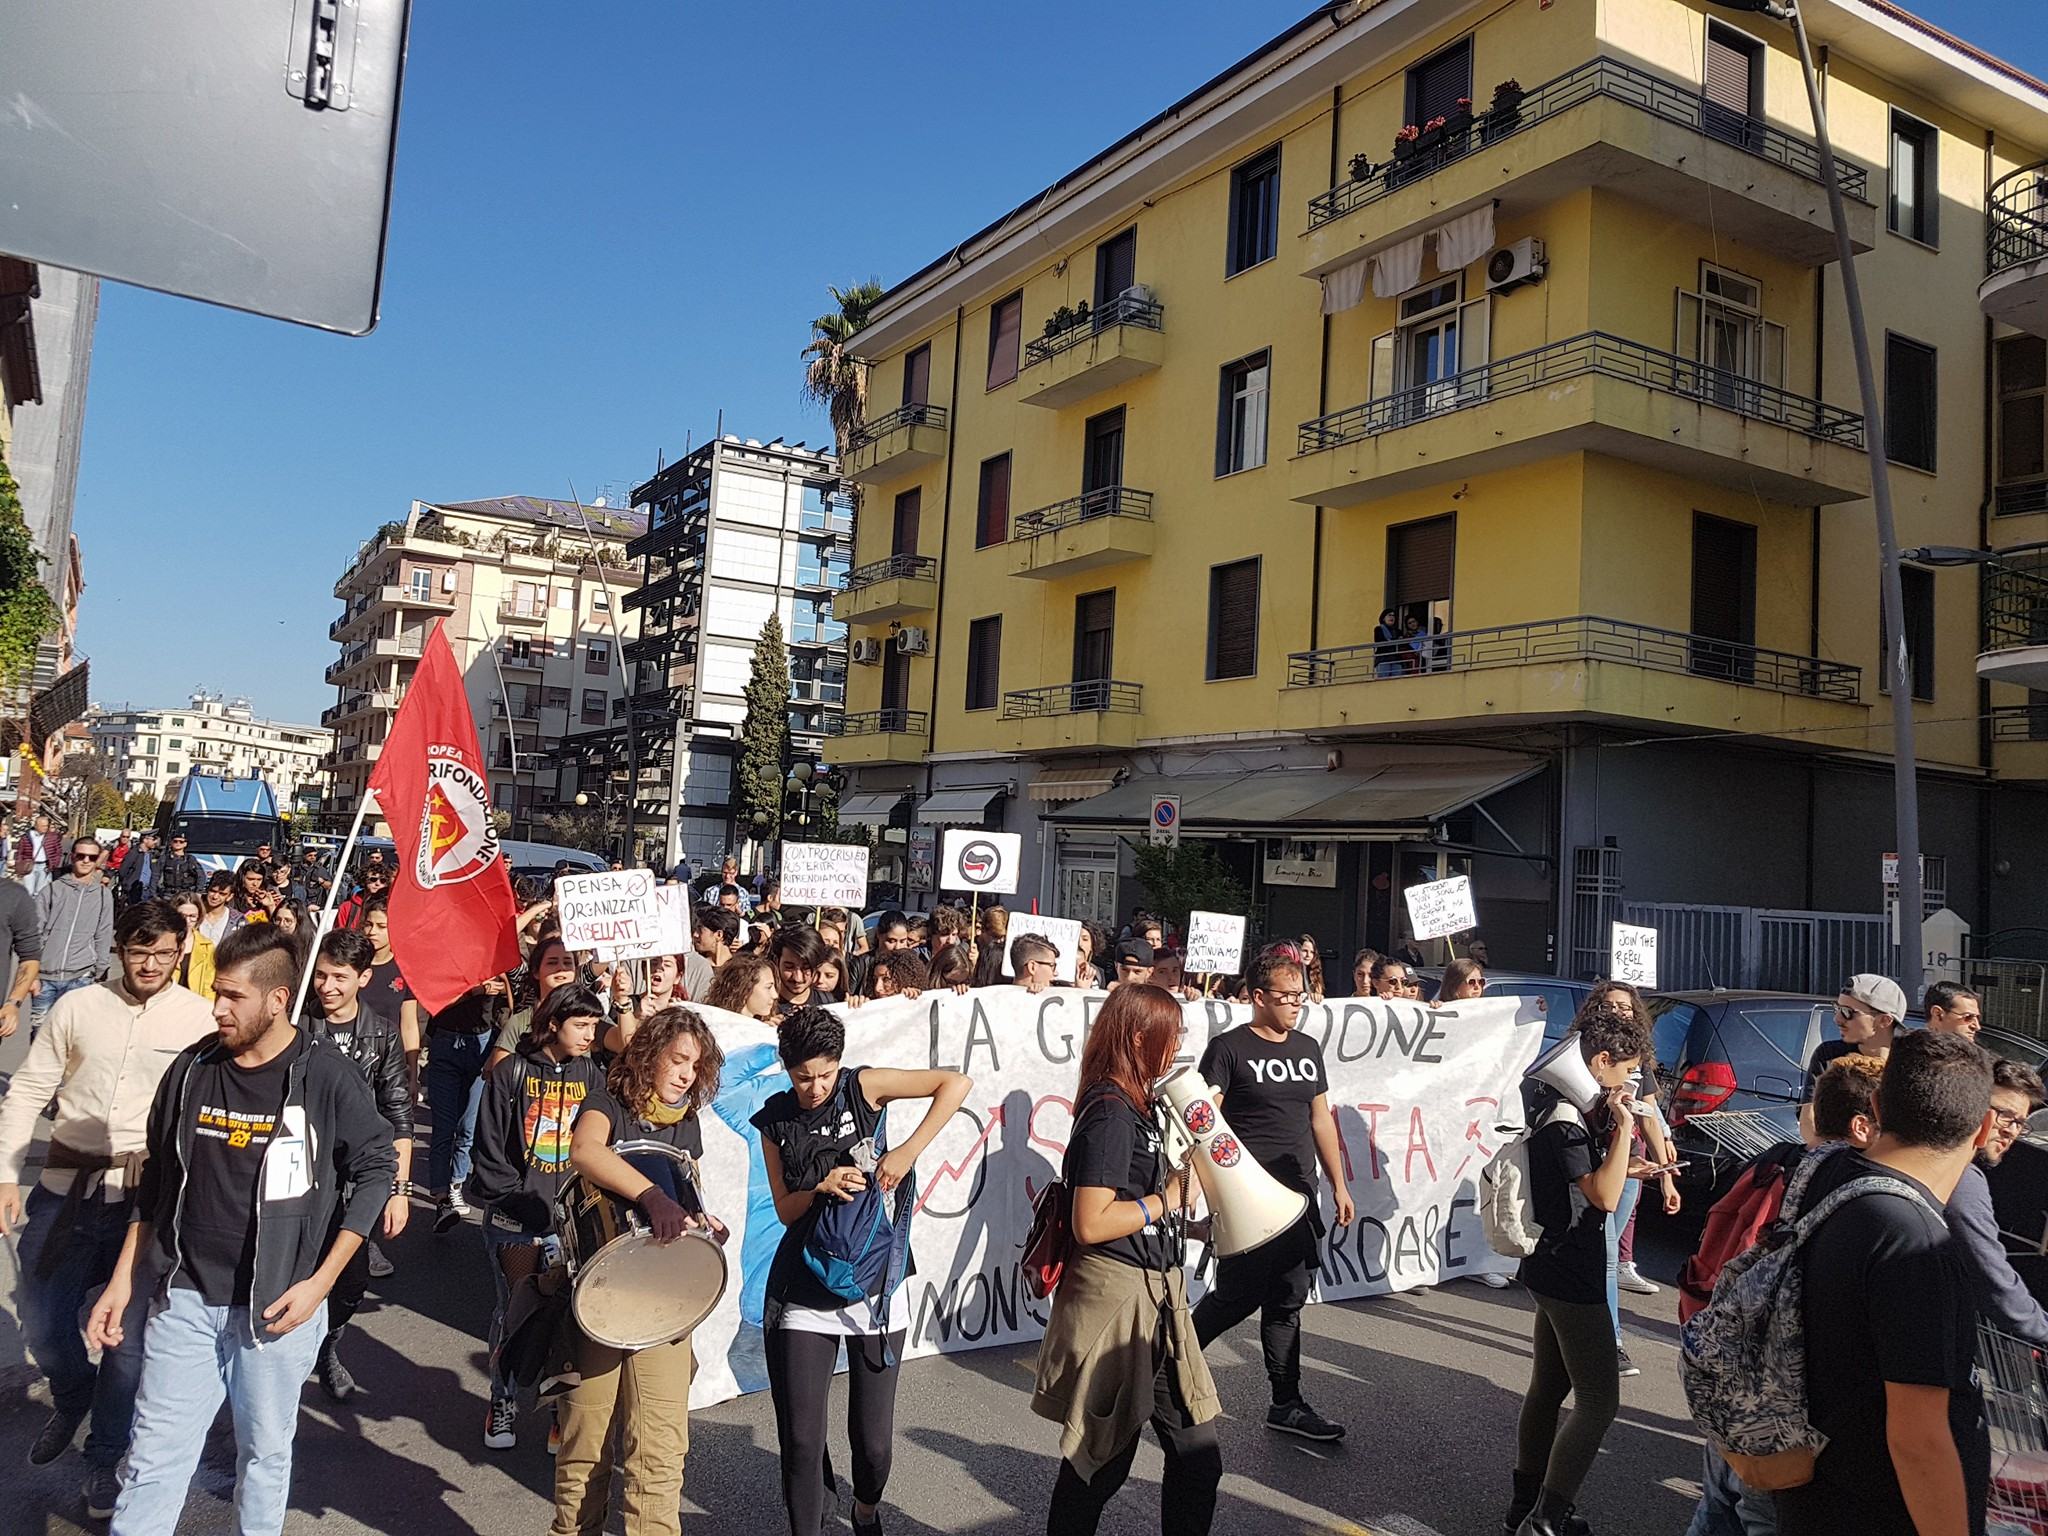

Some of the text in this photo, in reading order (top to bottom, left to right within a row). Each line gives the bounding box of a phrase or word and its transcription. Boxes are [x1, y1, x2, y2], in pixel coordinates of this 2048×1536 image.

[563, 877, 622, 898] PENSA
[783, 887, 817, 898] SCUOLE
[820, 888, 828, 899] E
[564, 899, 646, 921] ORGANIZZATI
[566, 920, 640, 943] RIBELLATI
[1191, 916, 1200, 931] LA
[1619, 930, 1654, 947] JOIN THE
[1614, 950, 1643, 966] REBEL
[1928, 951, 1947, 967] 18
[930, 997, 1000, 1074] LA
[1248, 1058, 1317, 1083] YOLO
[912, 1262, 1019, 1349] NON
